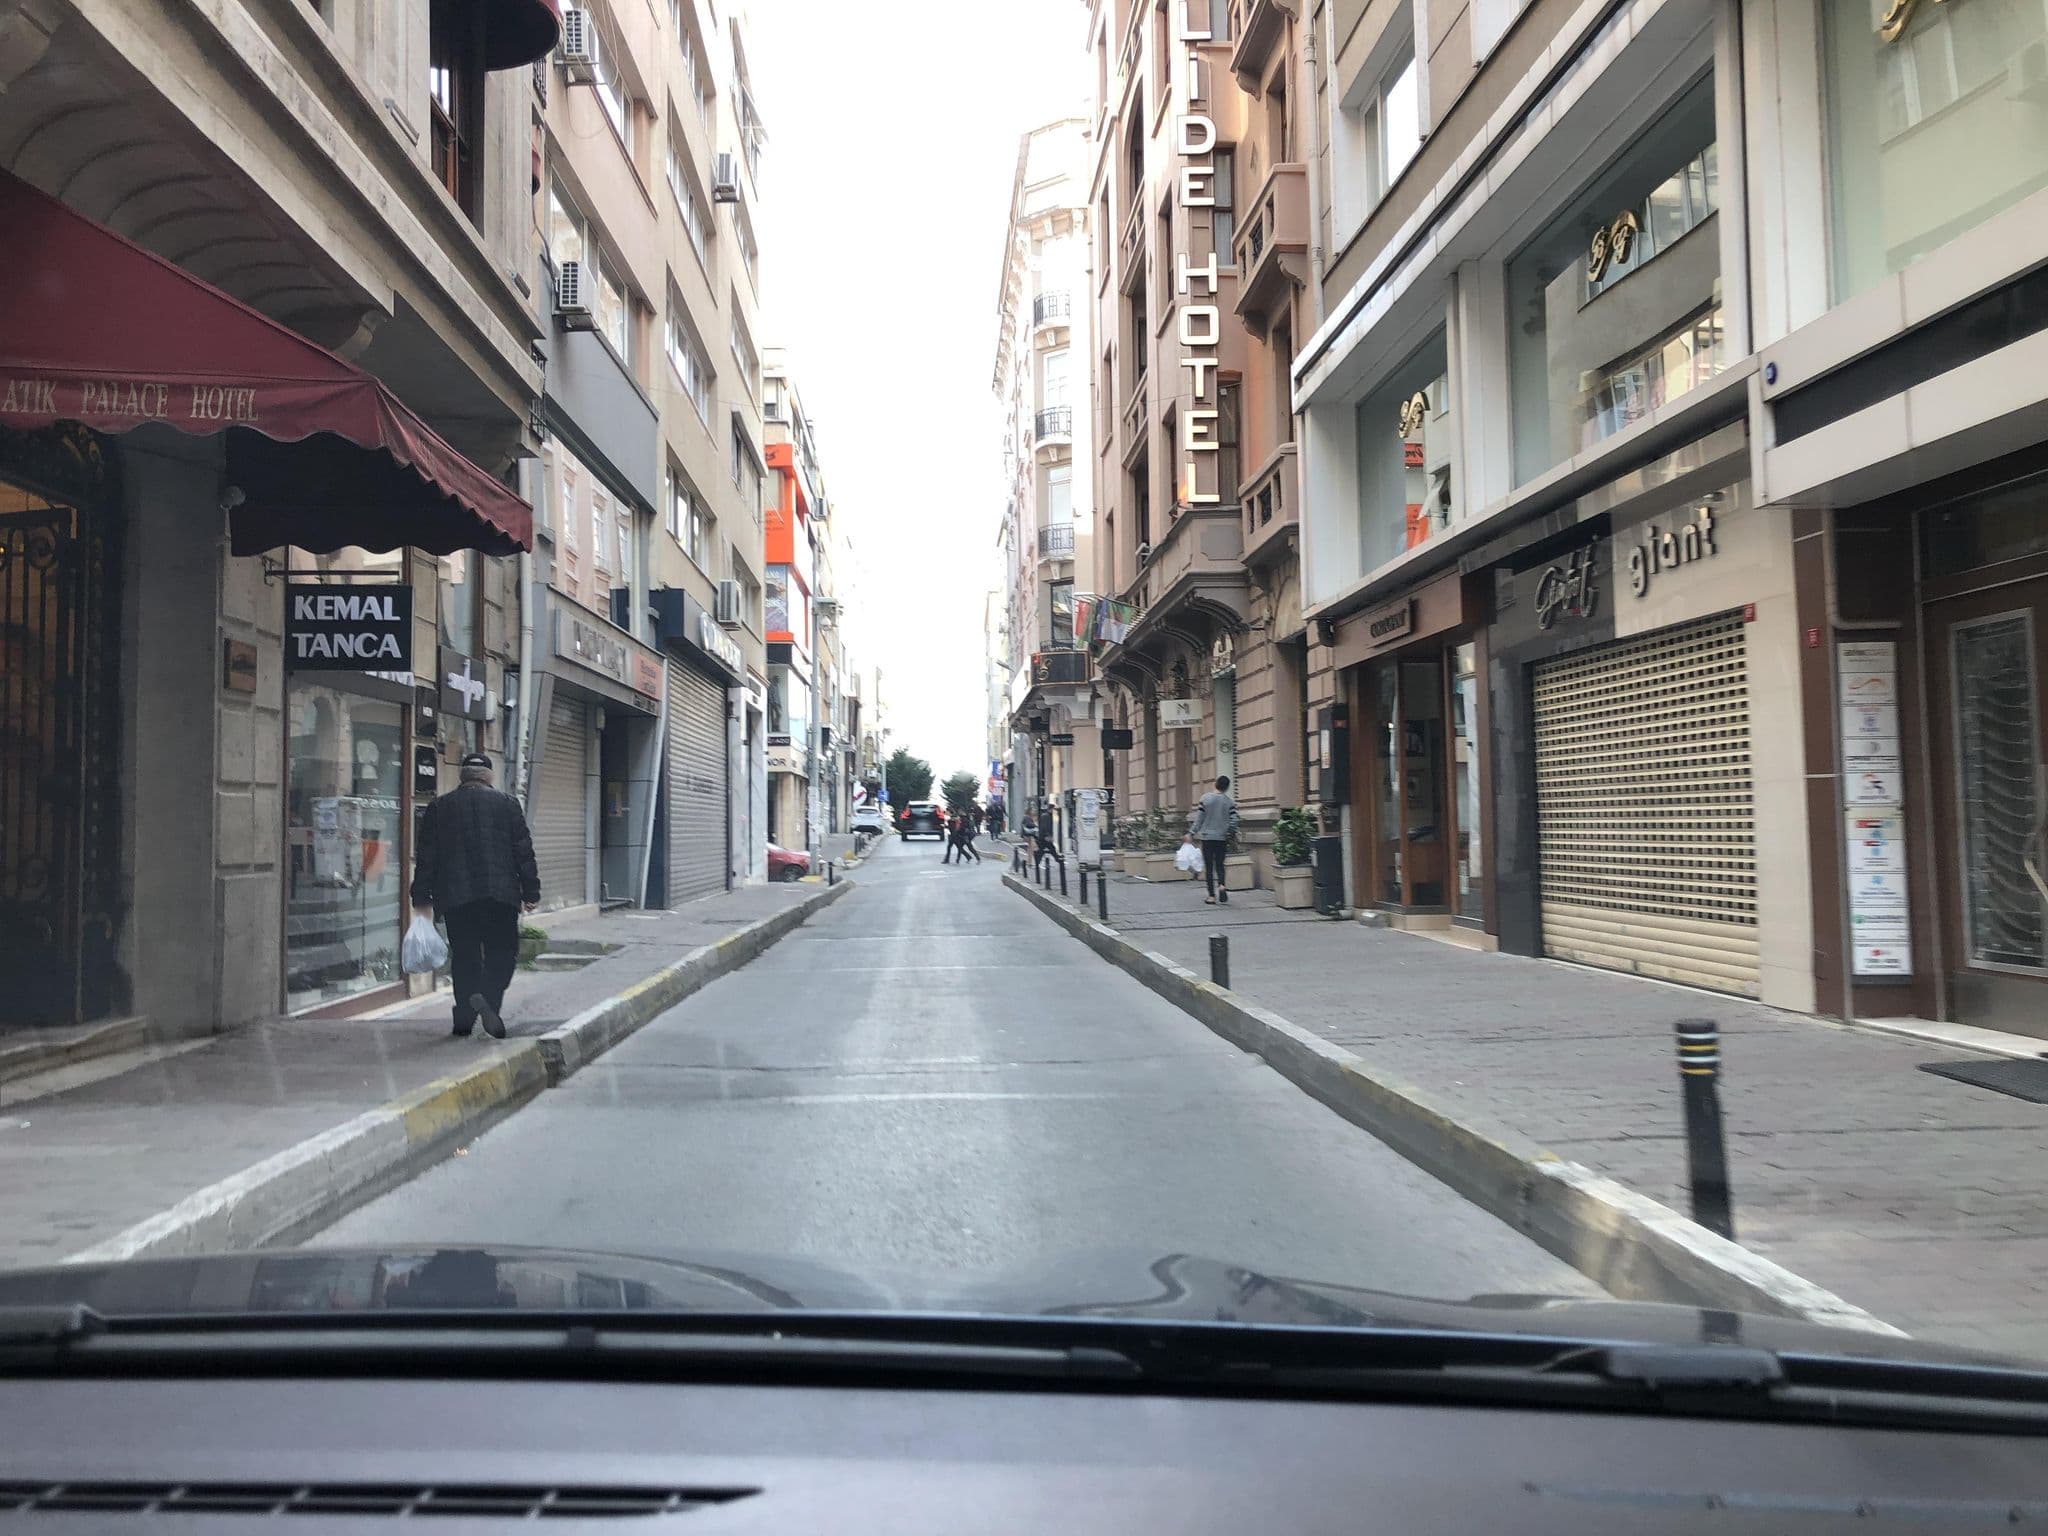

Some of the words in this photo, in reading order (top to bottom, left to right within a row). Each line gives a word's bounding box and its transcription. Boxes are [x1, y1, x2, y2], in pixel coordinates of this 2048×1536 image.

[1178, 252, 1220, 503] HOTEL
[81, 382, 169, 418] PALACE
[190, 386, 260, 421] HOTEL
[1628, 507, 1717, 597] giant
[294, 595, 400, 621] KEMAL
[292, 633, 402, 658] TANCA
